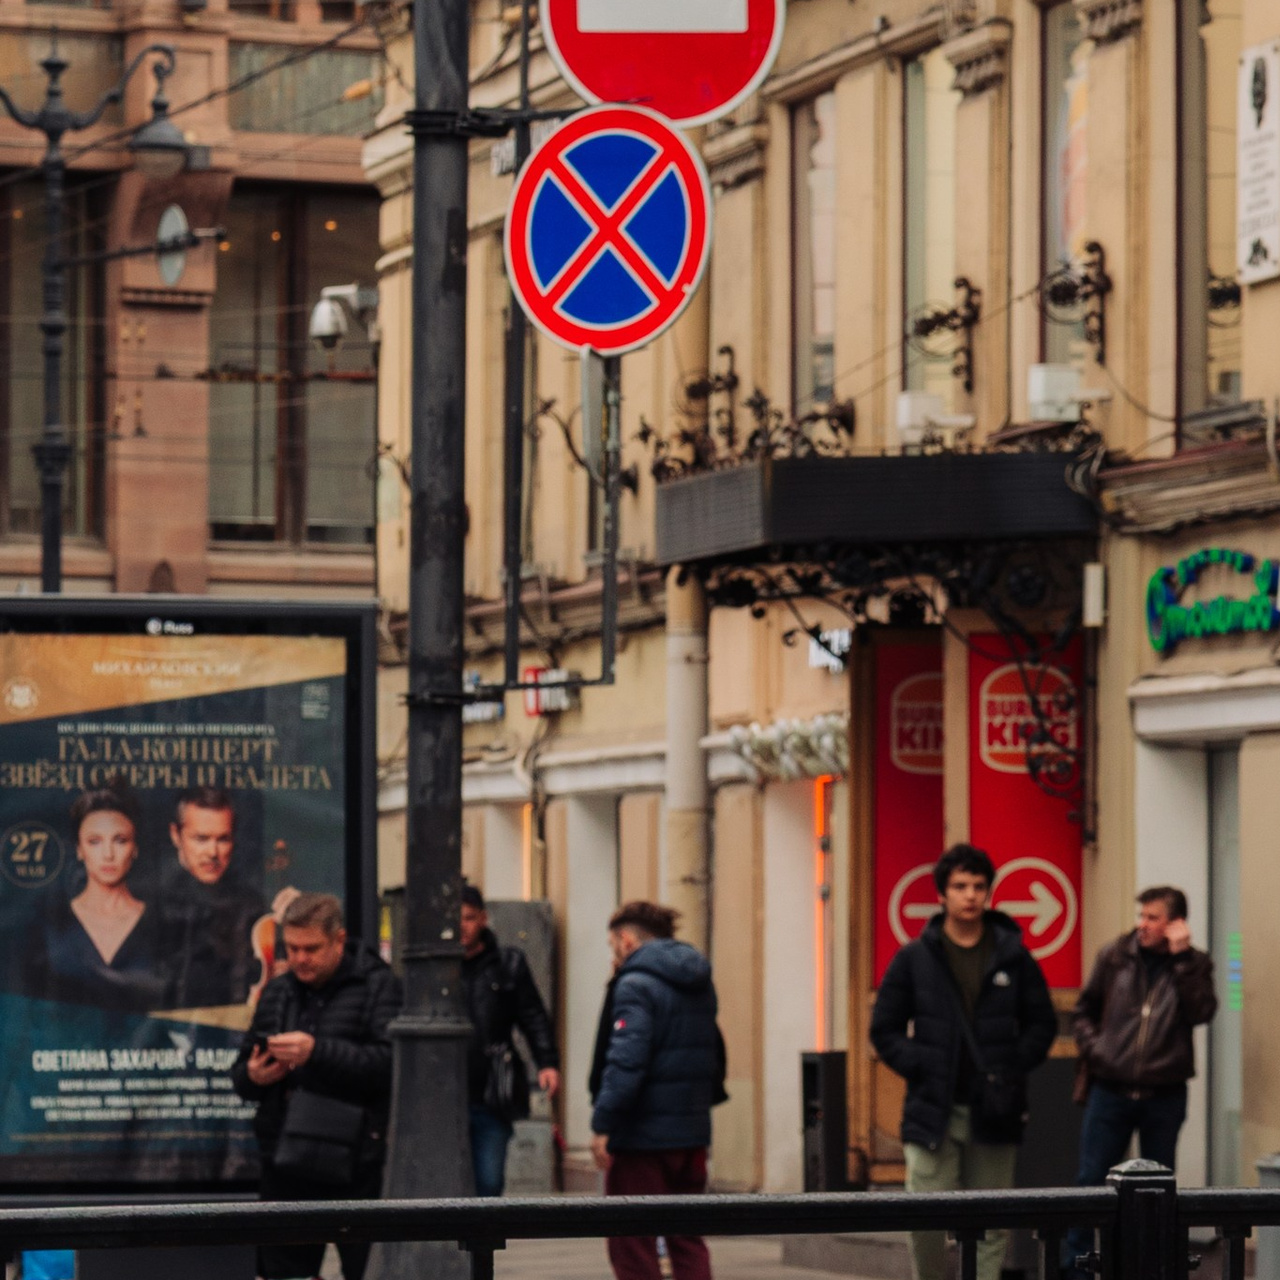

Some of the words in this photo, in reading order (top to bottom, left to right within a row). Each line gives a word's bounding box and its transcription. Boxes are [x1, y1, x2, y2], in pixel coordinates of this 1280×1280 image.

[58, 737, 278, 764] ГАЛА-КОНЦЕРТ
[1, 759, 85, 790] ЗВЁЗД
[196, 765, 216, 789] И
[224, 764, 332, 789] БАЛЕТА
[10, 831, 48, 862] 27
[32, 1049, 109, 1072] СВЕТЛАНА
[110, 1048, 187, 1071] ЗАХАРОВА
